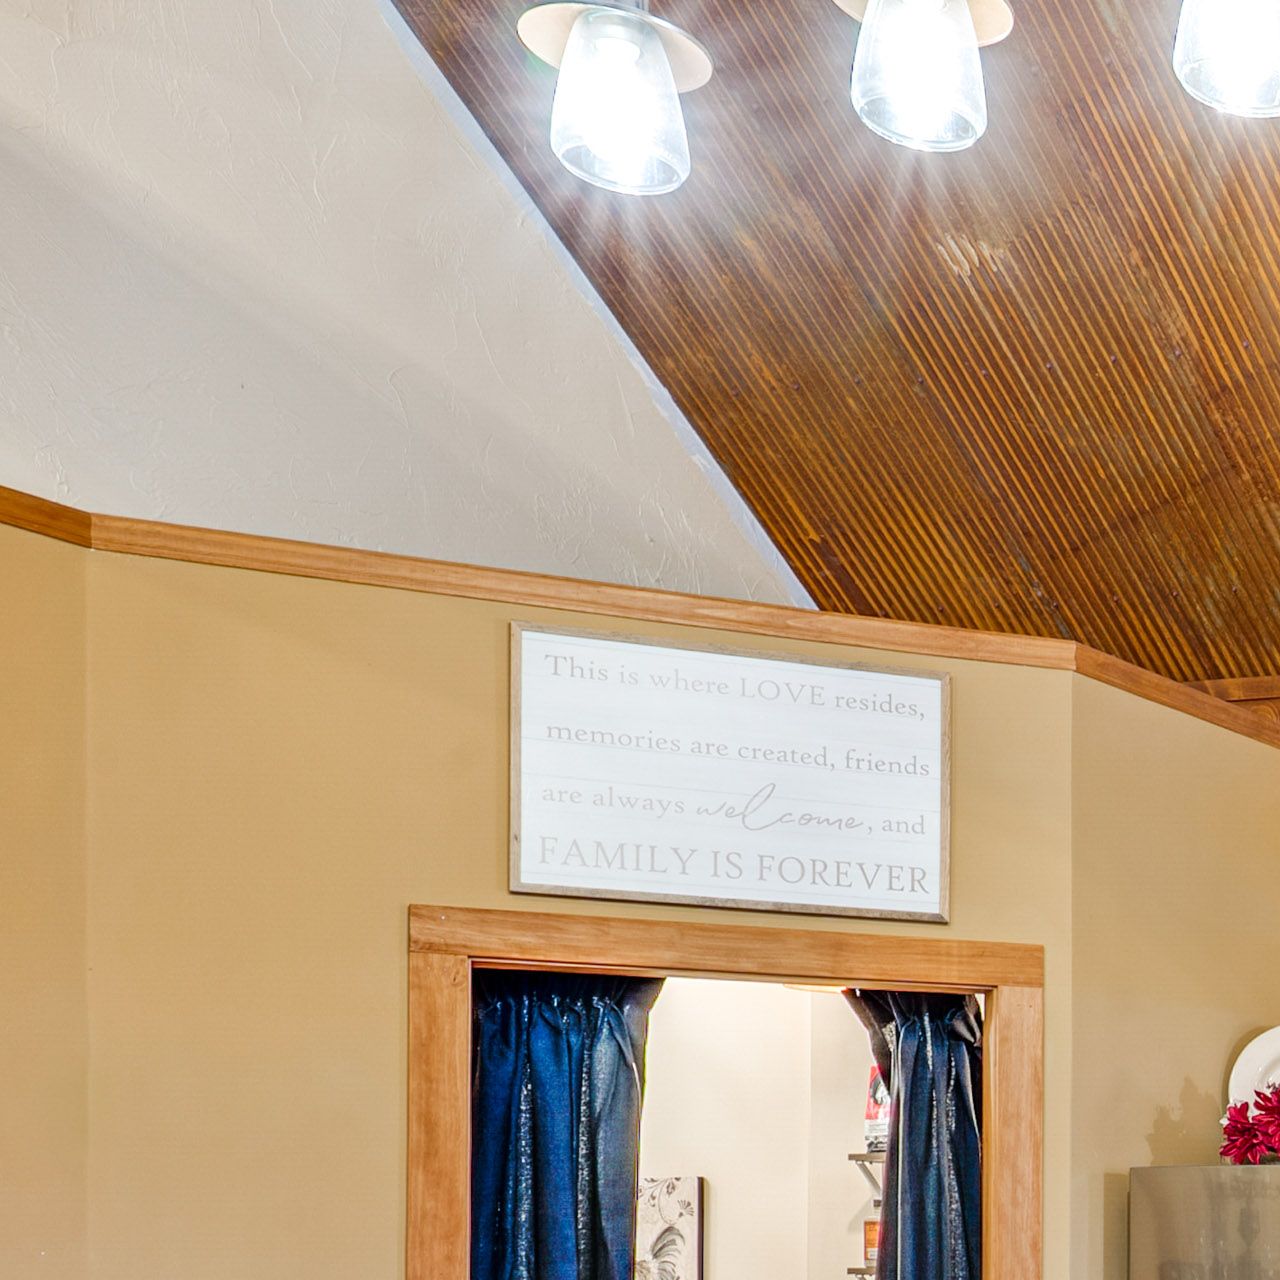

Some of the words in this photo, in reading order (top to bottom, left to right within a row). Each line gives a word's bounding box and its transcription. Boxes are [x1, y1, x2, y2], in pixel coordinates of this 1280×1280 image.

[544, 654, 609, 682] This
[618, 664, 640, 687] is
[648, 668, 730, 696] where
[739, 677, 826, 708] LOVE
[834, 691, 926, 721] resides,
[545, 724, 682, 754] memories
[689, 739, 730, 758] are
[736, 744, 836, 771] created,
[843, 748, 931, 778] friends
[540, 787, 583, 805] are
[591, 786, 686, 819] always
[696, 782, 874, 835] welcome,
[880, 814, 926, 837] and
[537, 835, 699, 877] FAMILY
[709, 850, 745, 880] IS
[756, 853, 931, 896] FOREVER
